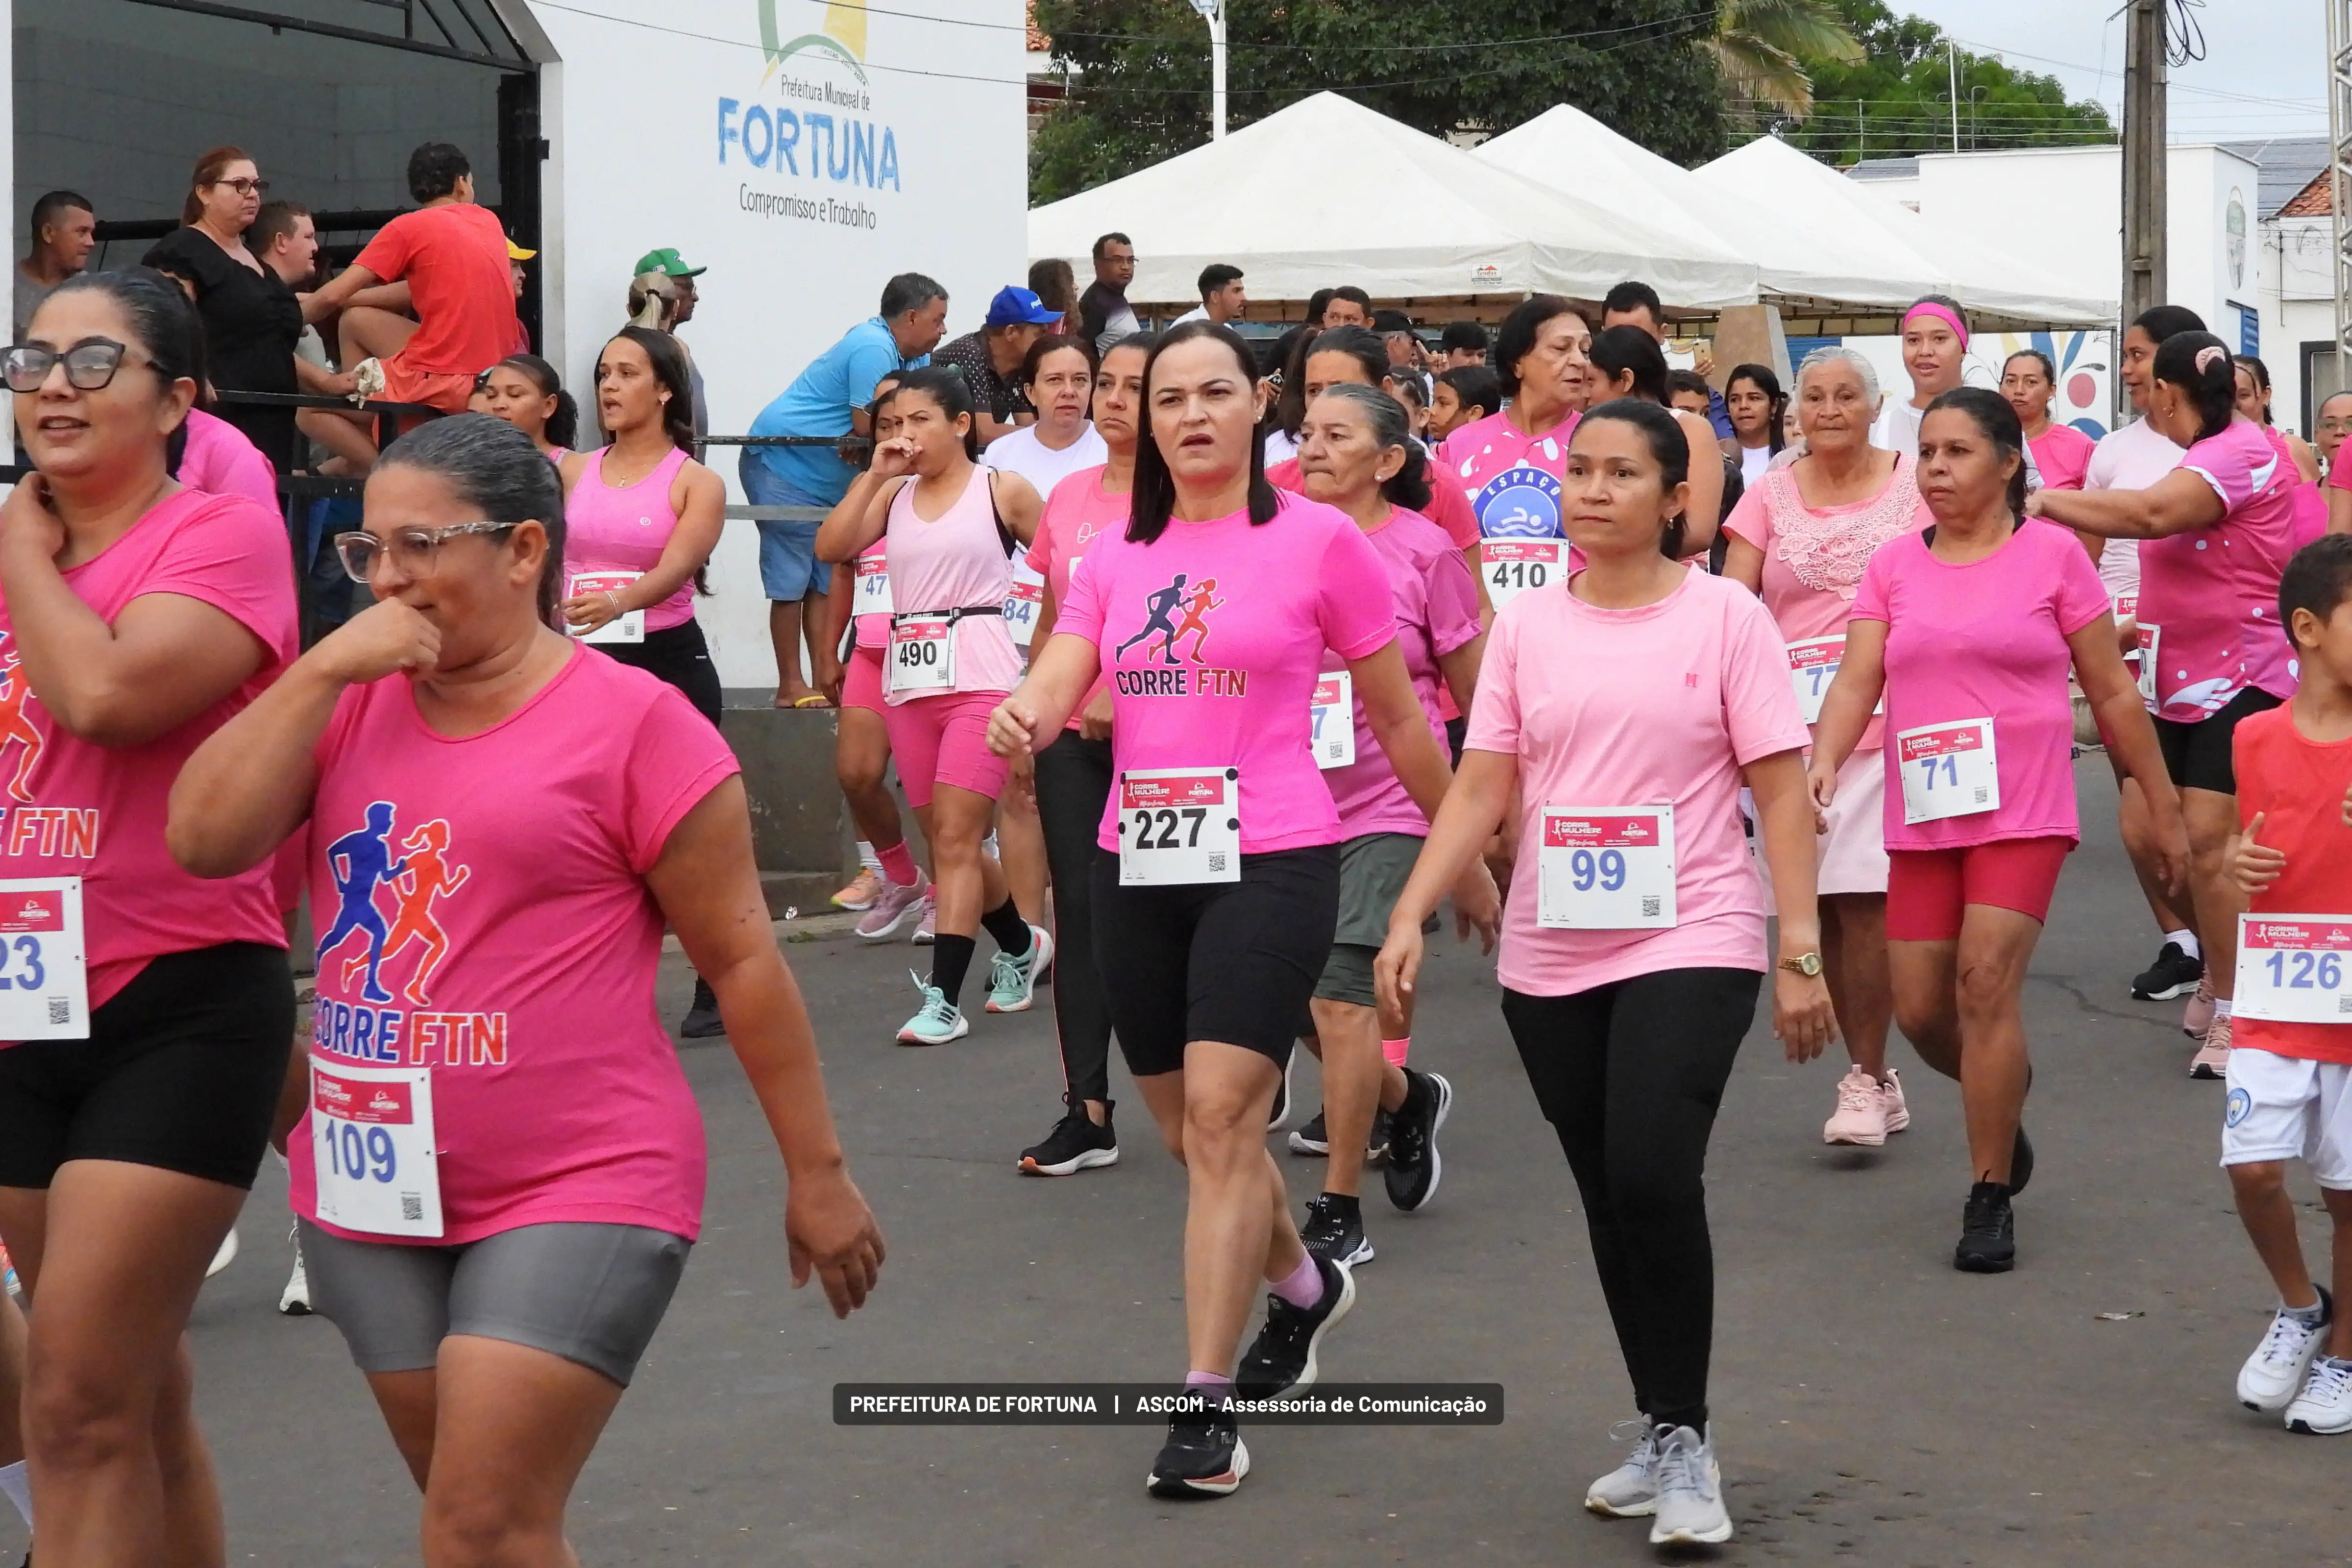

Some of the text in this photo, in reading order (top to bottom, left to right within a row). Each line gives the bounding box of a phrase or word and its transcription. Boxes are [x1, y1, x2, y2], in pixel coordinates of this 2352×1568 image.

[782, 74, 870, 111] Prefeitura Municipal de
[718, 97, 900, 192] FORTUNA
[740, 183, 876, 229] Compromisso e Trabalho
[1486, 471, 1561, 496] ESPAÇO
[866, 575, 887, 595] 47
[1493, 563, 1546, 588] 410
[1004, 598, 1030, 624] 84
[899, 641, 937, 667] 490
[1115, 668, 1248, 697] CORRE FTN
[1921, 754, 1958, 790] 71
[8, 807, 99, 858] FTN
[1135, 808, 1206, 850] 227
[1571, 849, 1626, 891] 99
[2266, 951, 2342, 989] 126
[409, 1011, 508, 1066] FTN
[325, 1119, 397, 1183] 109
